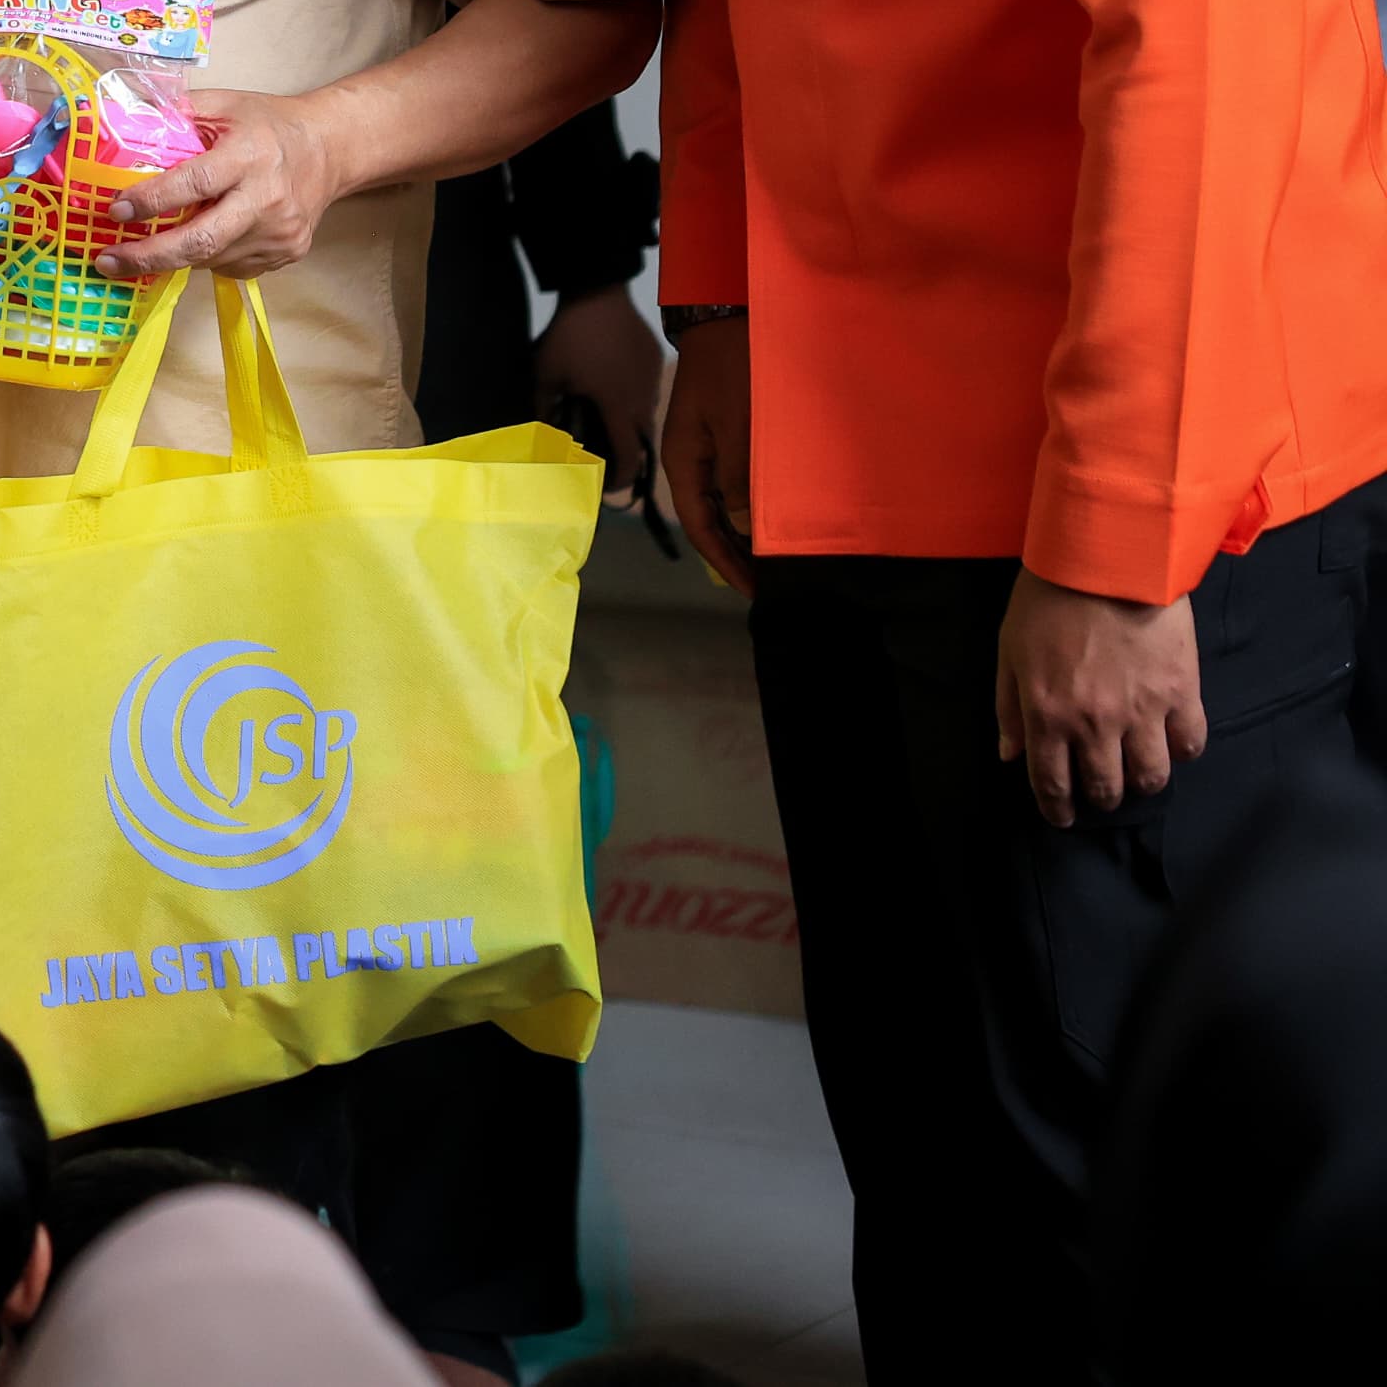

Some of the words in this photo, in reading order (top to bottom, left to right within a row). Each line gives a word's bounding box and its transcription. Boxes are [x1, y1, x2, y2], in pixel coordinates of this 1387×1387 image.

[51, 26, 69, 35] MADE
[79, 30, 114, 42] INDONESIA
[228, 709, 359, 809] JSP
[40, 950, 146, 1008] JAYA
[150, 935, 288, 995] SETYA
[291, 917, 480, 981] PLASTIK
